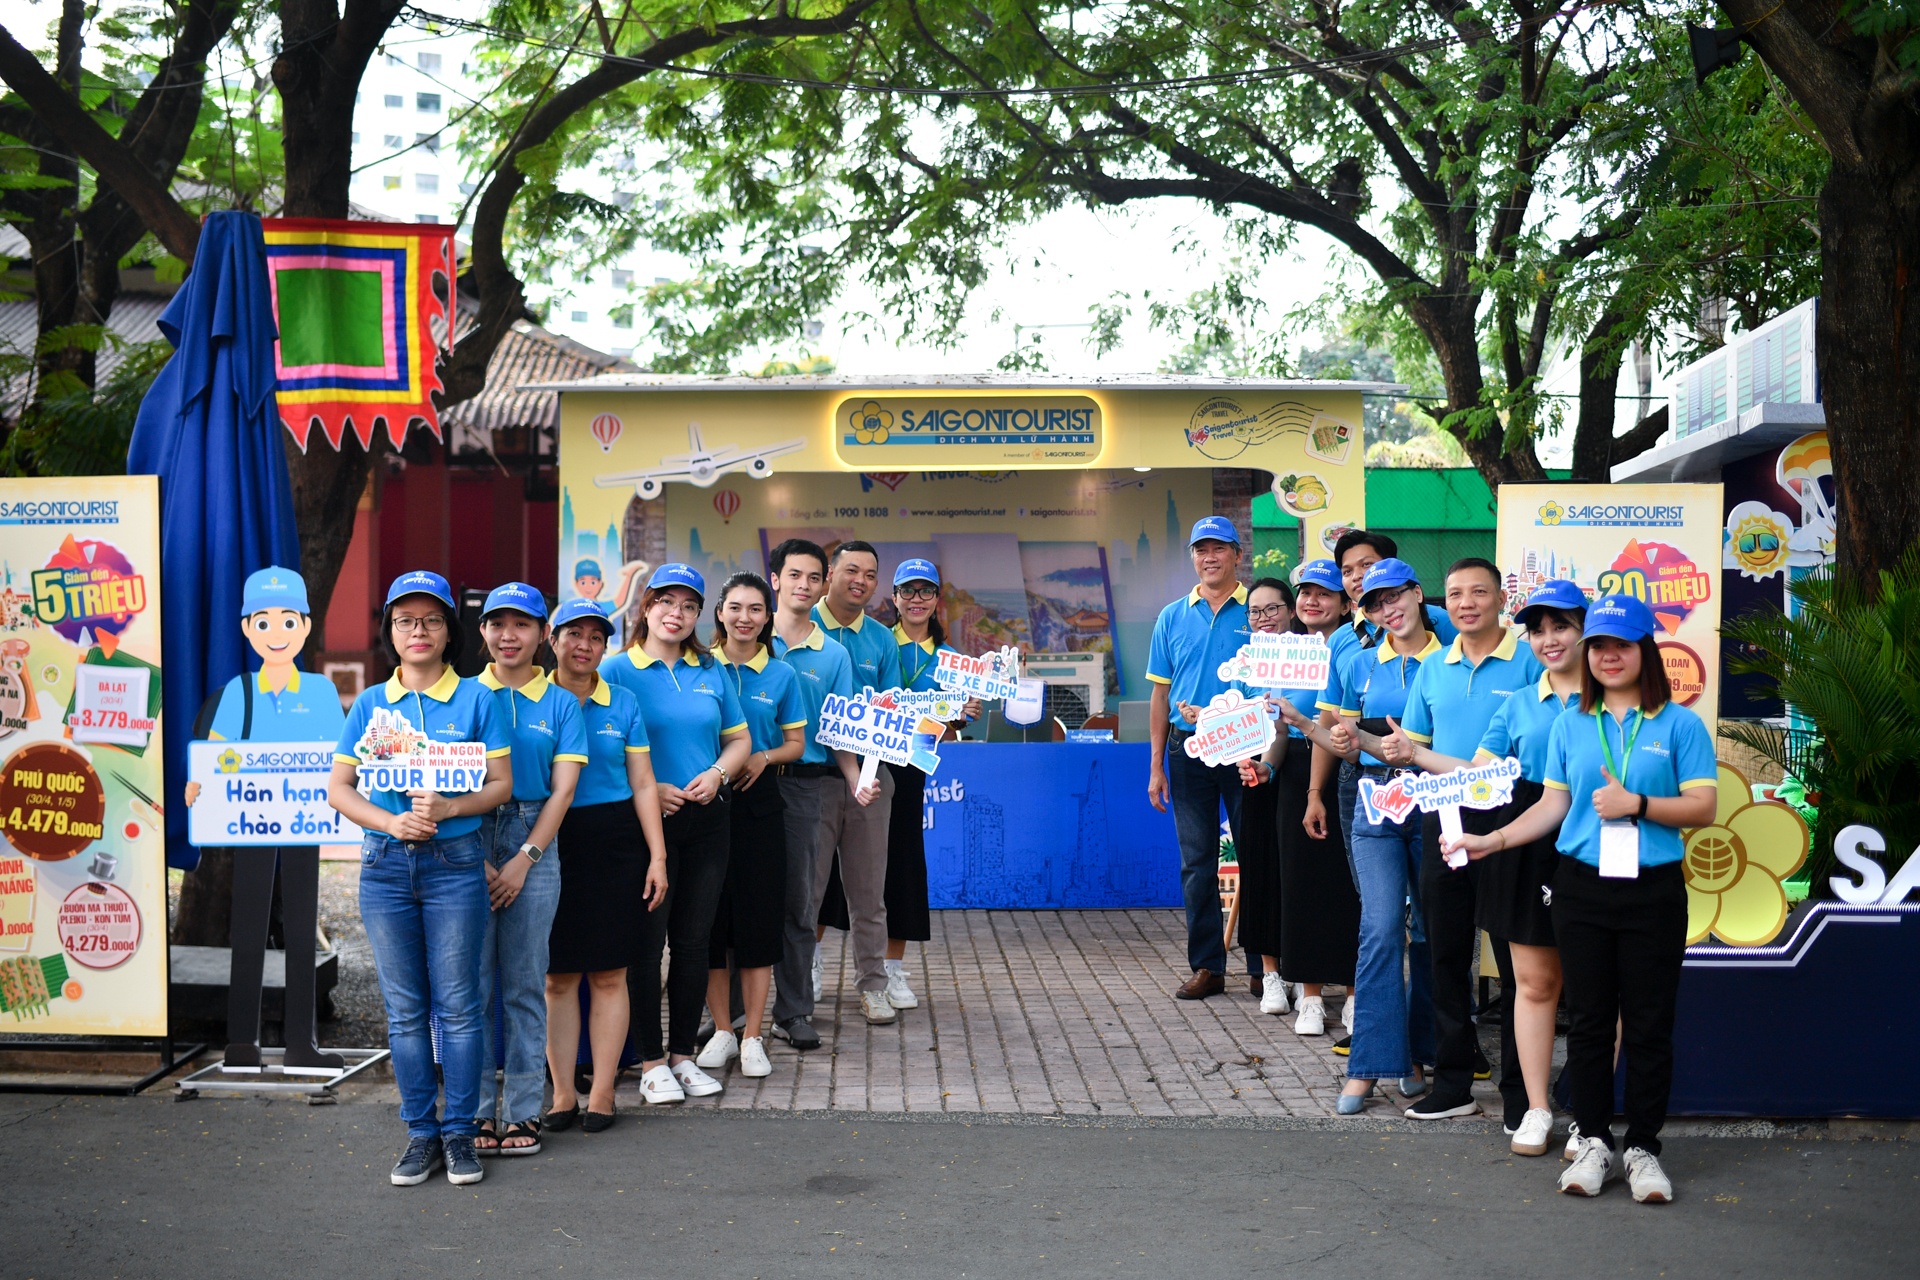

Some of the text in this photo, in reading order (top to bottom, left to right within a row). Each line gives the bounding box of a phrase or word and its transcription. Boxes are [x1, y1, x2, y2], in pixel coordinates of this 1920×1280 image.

[901, 409, 1094, 431] SAIGONTOURIST
[1204, 414, 1258, 434] Saigontourist
[1212, 429, 1234, 440] Travel
[0, 501, 119, 517] SAIGONTOURIST
[834, 508, 860, 518] 1900
[863, 508, 889, 518] 1808
[911, 508, 1007, 519] www.saigontourist.net
[1568, 506, 1684, 519] SAIGONTOURIST
[34, 570, 145, 623] 5 TRIỆU
[1646, 574, 1707, 606] TRIỆU
[939, 651, 985, 676] TEAM
[1256, 662, 1327, 681] ĐI CHƠI
[1666, 658, 1690, 668] LOAN
[936, 669, 957, 685] MÊ
[962, 675, 980, 690] XÊ
[985, 681, 1017, 699] DỊCH
[893, 690, 968, 705] Saigontourist
[824, 694, 917, 737] MỞ THẺ
[820, 717, 909, 753] TẶNG QUÀ
[1187, 711, 1259, 754] CHECK-IN
[1243, 729, 1262, 742] XINH
[450, 745, 483, 756] NGON
[817, 733, 907, 764] #Saigontourist Travel
[13, 769, 86, 793] PHÚ QUỐC
[359, 769, 484, 789] TOUR HAY
[1403, 761, 1518, 796] Saigontourist
[226, 779, 273, 802] Hân
[1418, 788, 1464, 809] Travel
[8, 806, 103, 839] 4.479.000đ
[227, 810, 340, 835] chào đón!
[88, 903, 100, 912] MA
[60, 915, 86, 924] PLEIKU
[94, 914, 111, 924] KON
[65, 934, 134, 951] 4.279.000đ
